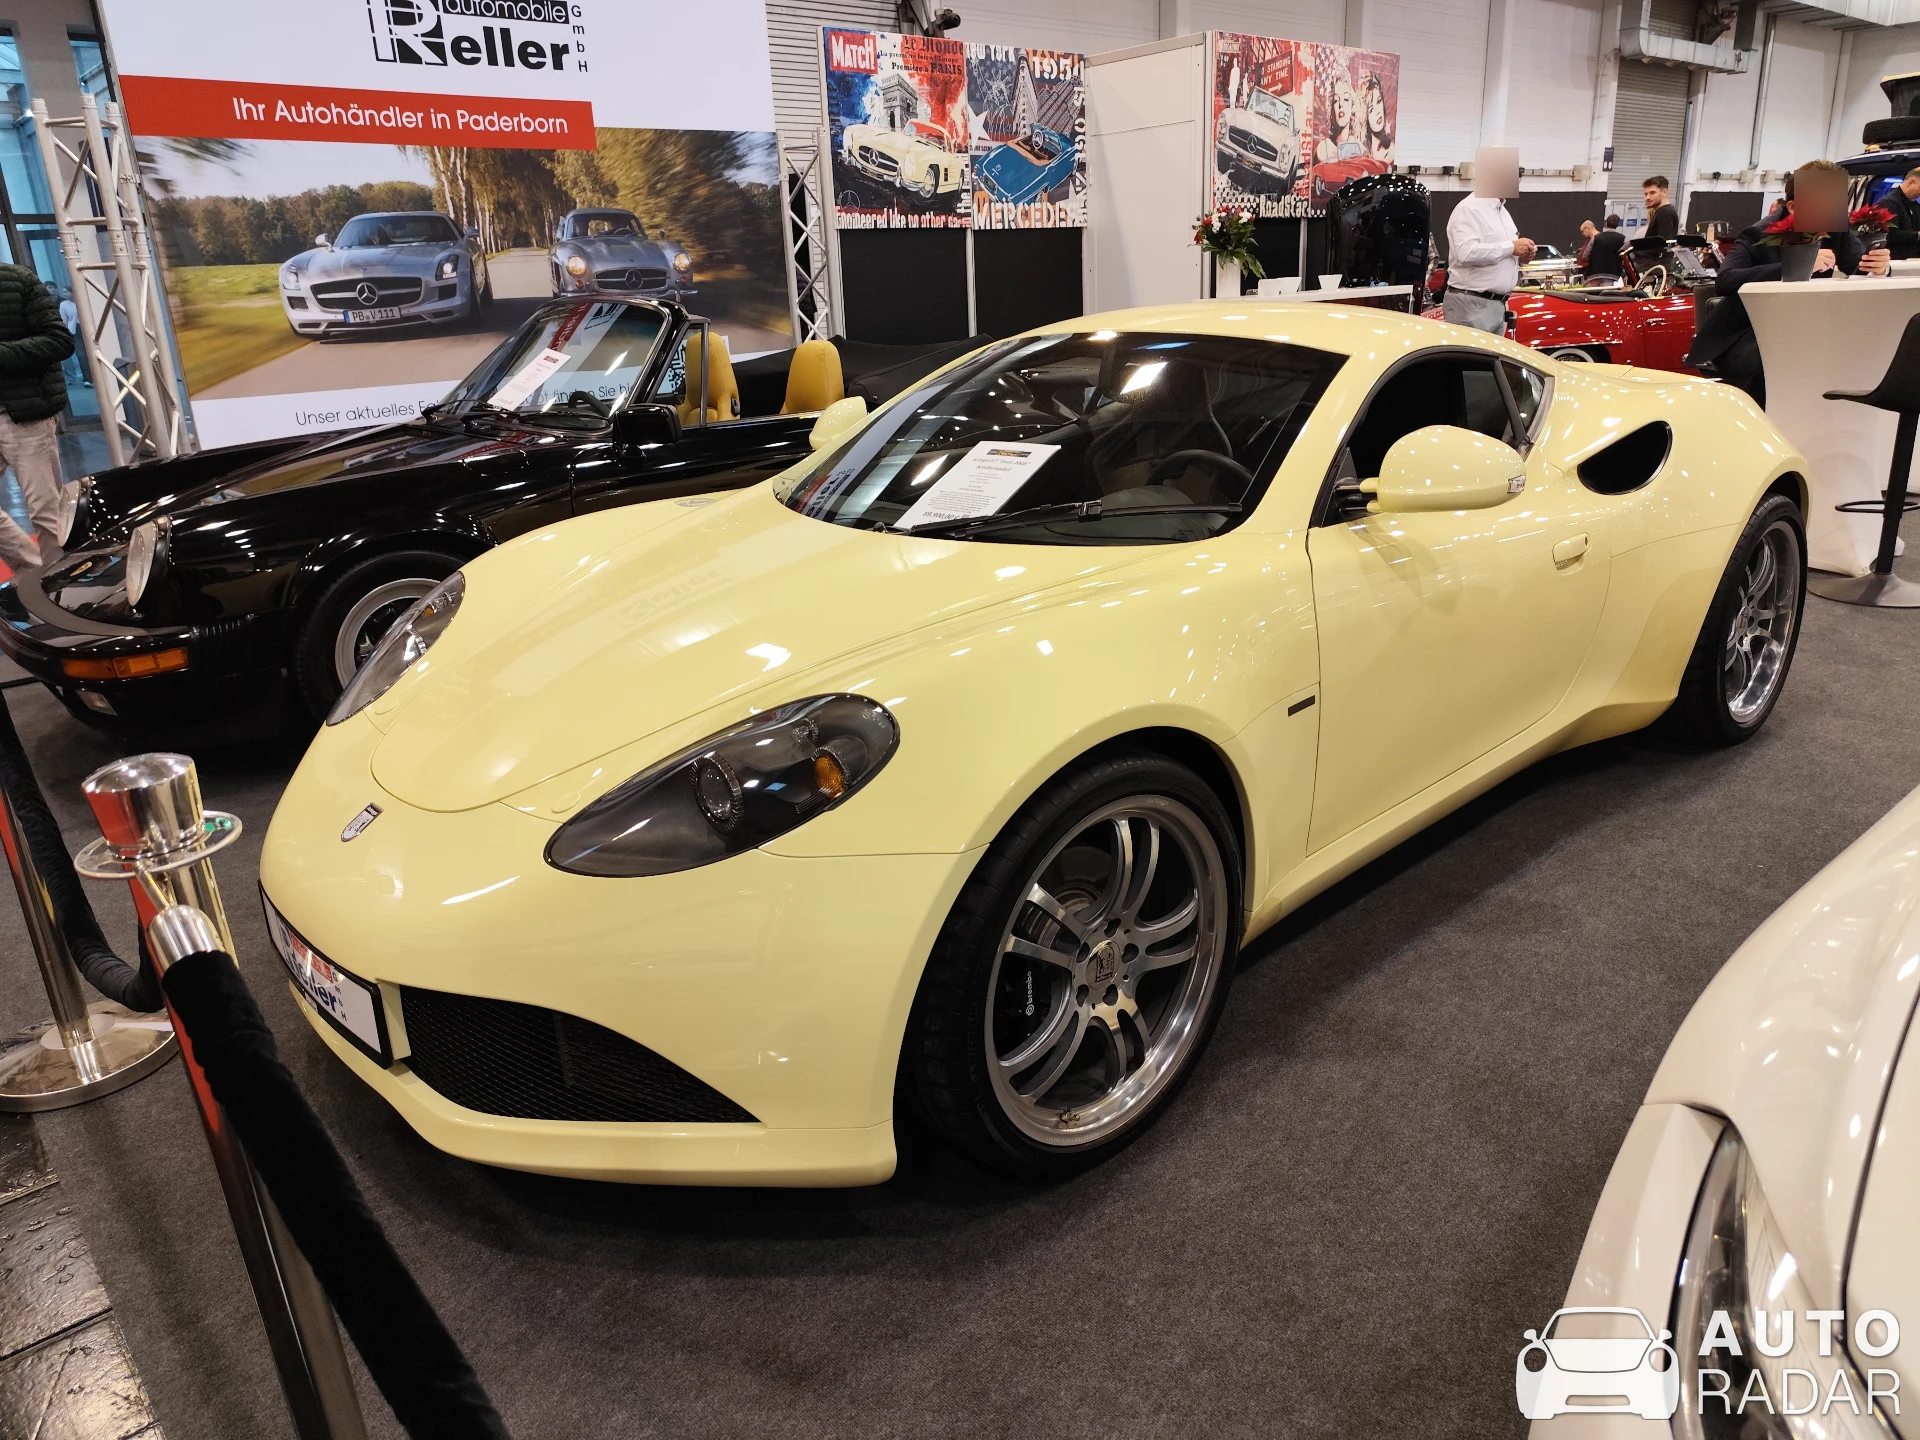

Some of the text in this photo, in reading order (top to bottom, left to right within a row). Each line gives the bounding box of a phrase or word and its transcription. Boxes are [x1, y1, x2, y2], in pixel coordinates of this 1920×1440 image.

[831, 34, 876, 70] MATCH
[930, 63, 963, 75] PARIS
[1267, 57, 1291, 73] STANDING
[1275, 68, 1289, 80] TIME
[232, 96, 569, 134] Ihr Autohändler in Paderborn
[351, 311, 365, 321] PB
[598, 386, 616, 398] Sie
[295, 410, 341, 426] Unser
[345, 402, 415, 421] aktuelles
[1025, 970, 1033, 1004] brembo
